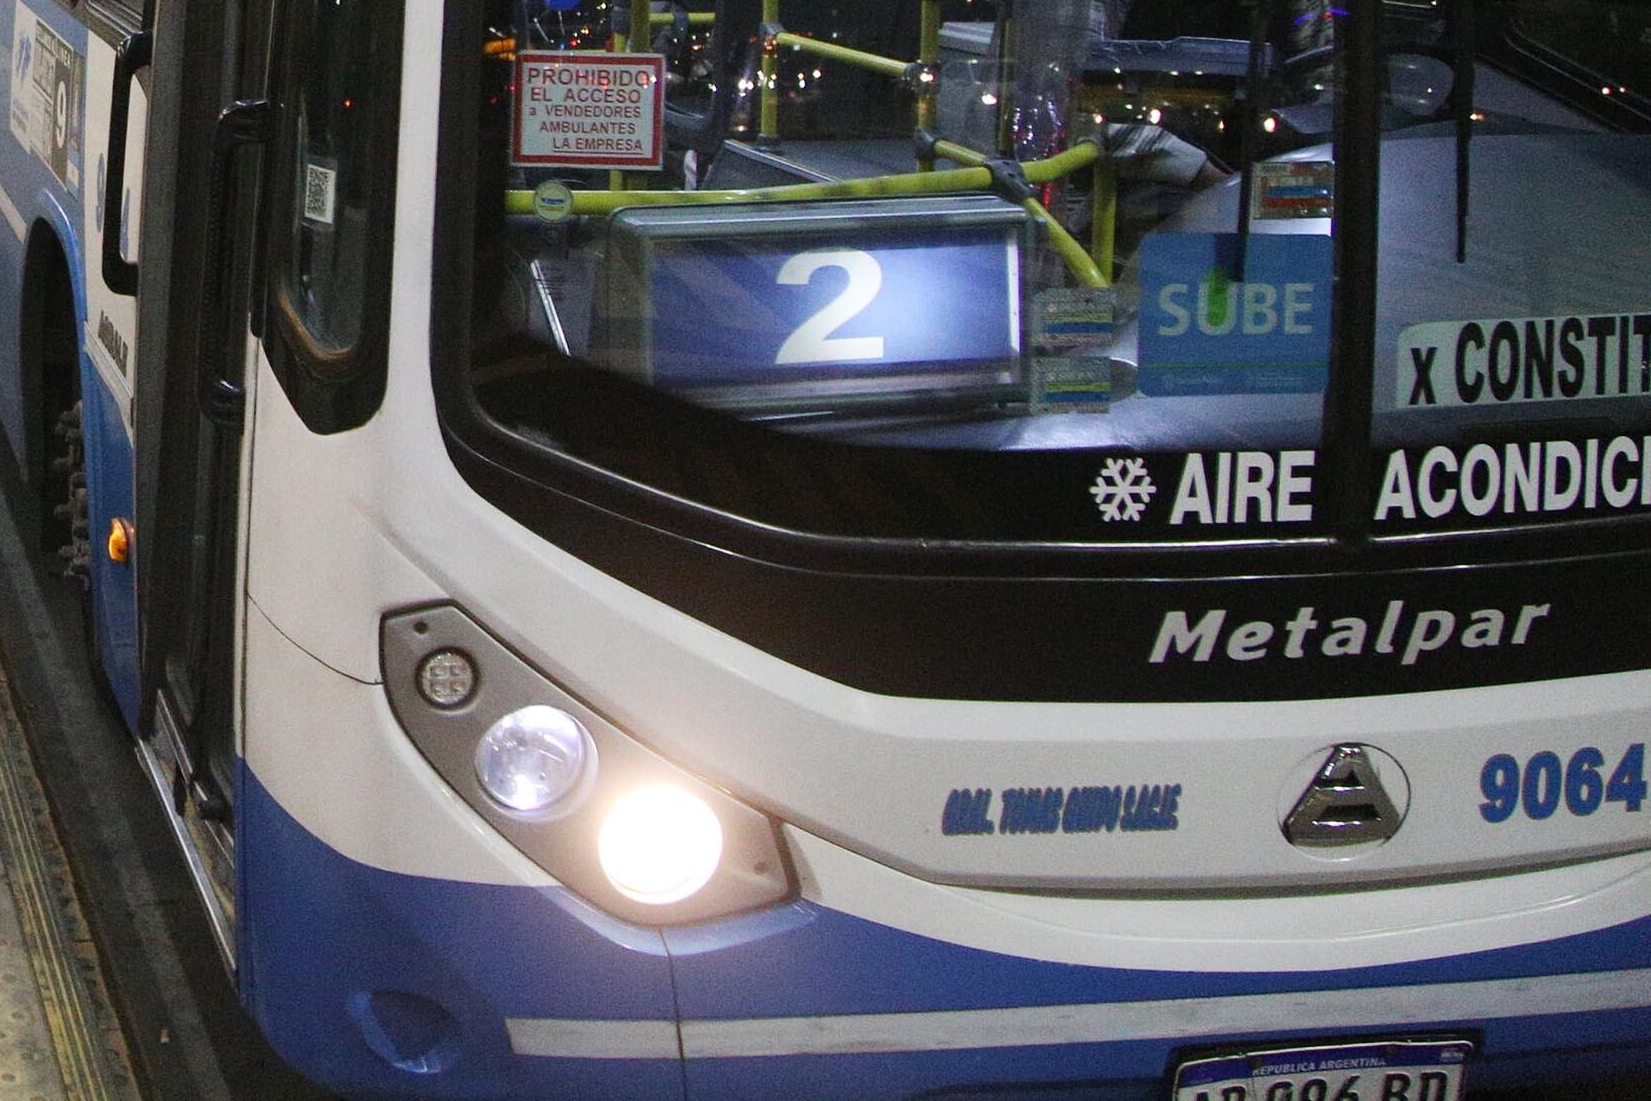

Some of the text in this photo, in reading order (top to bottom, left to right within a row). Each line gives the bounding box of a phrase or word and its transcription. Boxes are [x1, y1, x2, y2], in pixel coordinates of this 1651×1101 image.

[527, 67, 650, 87] PROHIBIDO
[530, 87, 642, 103] EL ACCESO
[56, 81, 67, 148] 9
[540, 121, 637, 135] AMBULANTES
[545, 105, 642, 118] VENDEDORES
[552, 138, 643, 151] LA EMPRESA
[775, 248, 885, 365] 2
[1159, 283, 1315, 336] SUBE
[1169, 450, 1316, 525] AIRE
[1148, 600, 1552, 666] Metalpar
[1478, 743, 1647, 824] 9064
[1318, 1056, 1387, 1071] ARGENTINA
